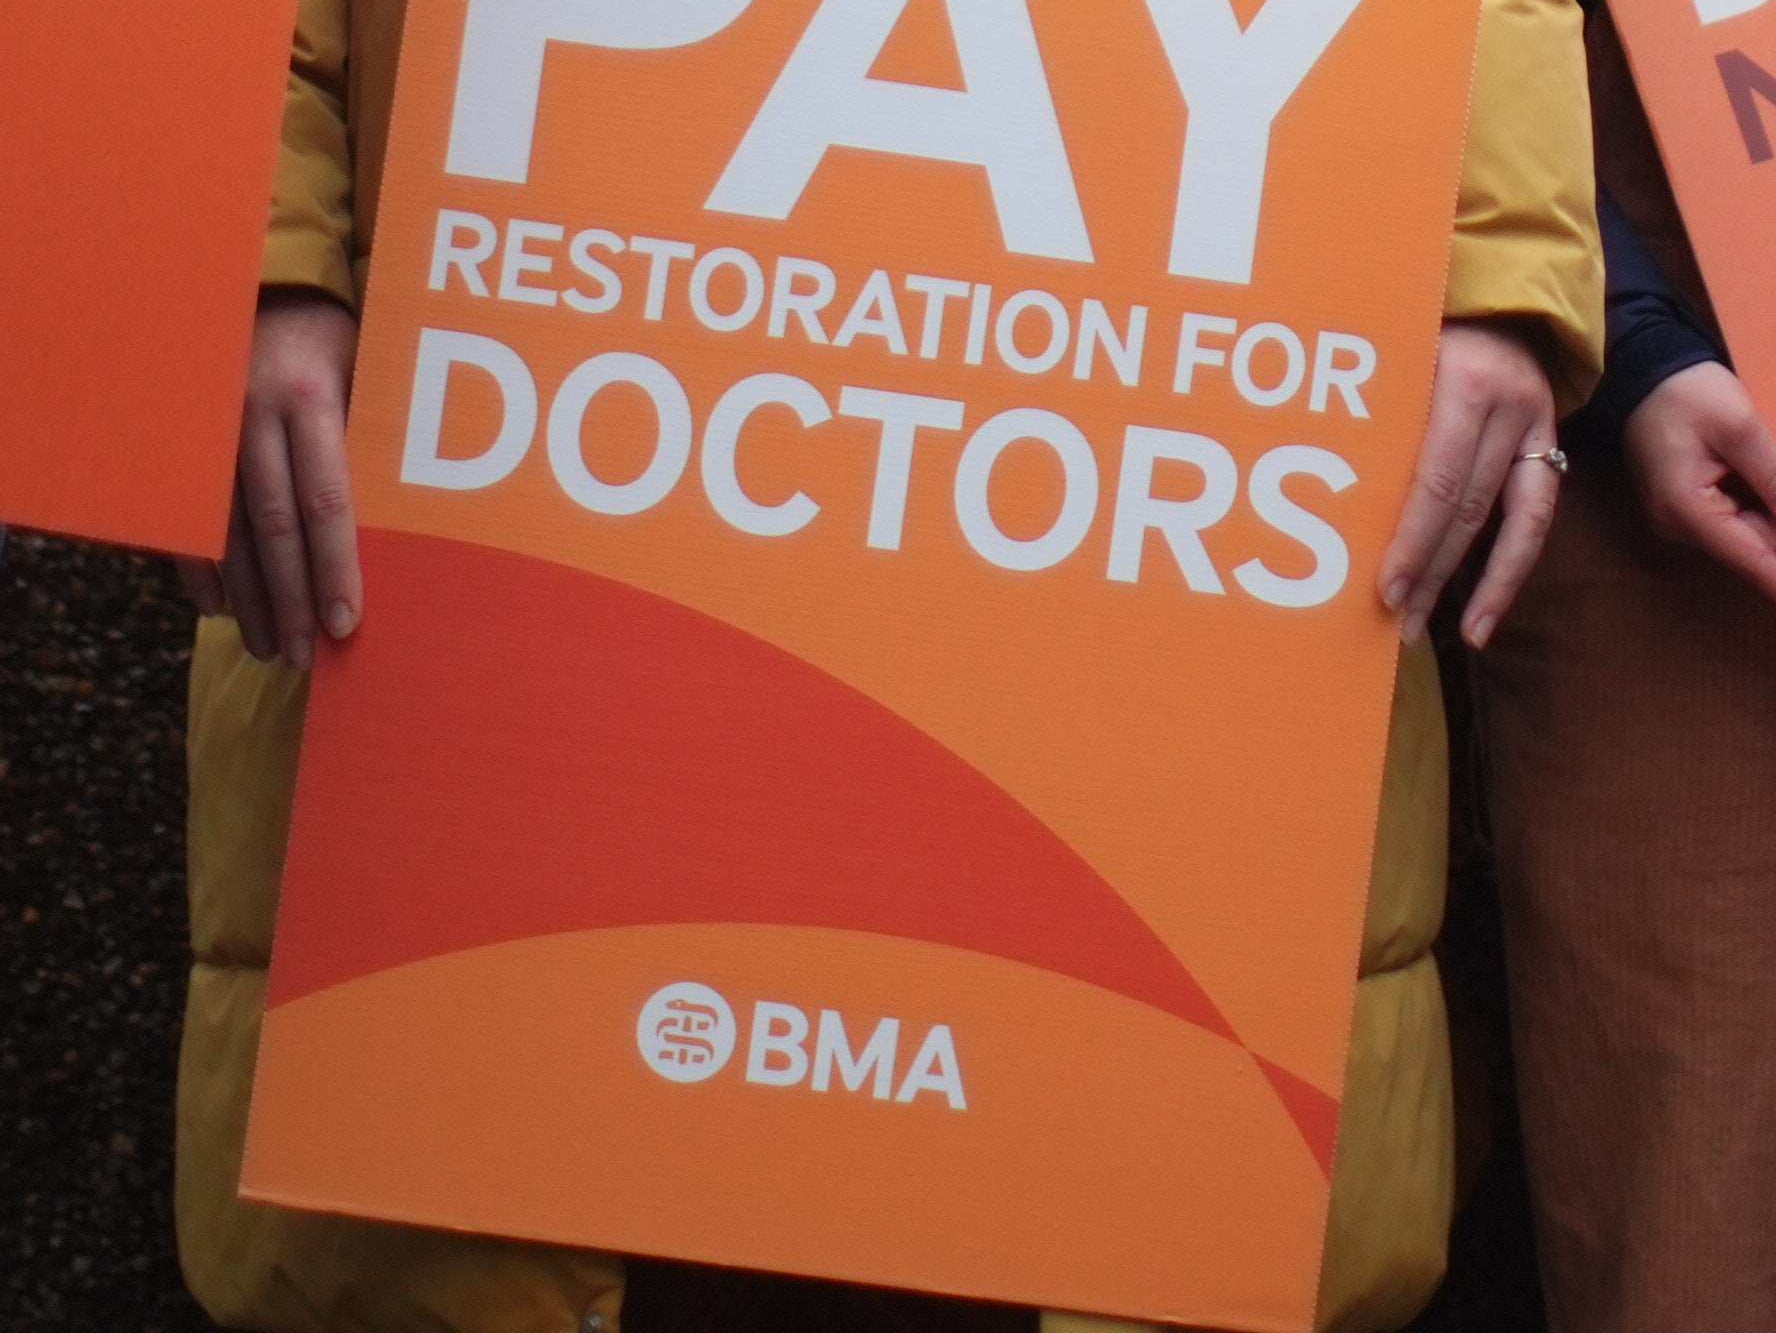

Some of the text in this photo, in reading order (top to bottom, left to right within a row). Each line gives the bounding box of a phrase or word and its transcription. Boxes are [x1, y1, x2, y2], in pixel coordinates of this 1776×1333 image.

[428, 209, 1376, 419] RESTORATION FOR
[400, 325, 1359, 608] DOCTORS
[745, 1001, 967, 1110] BMA
